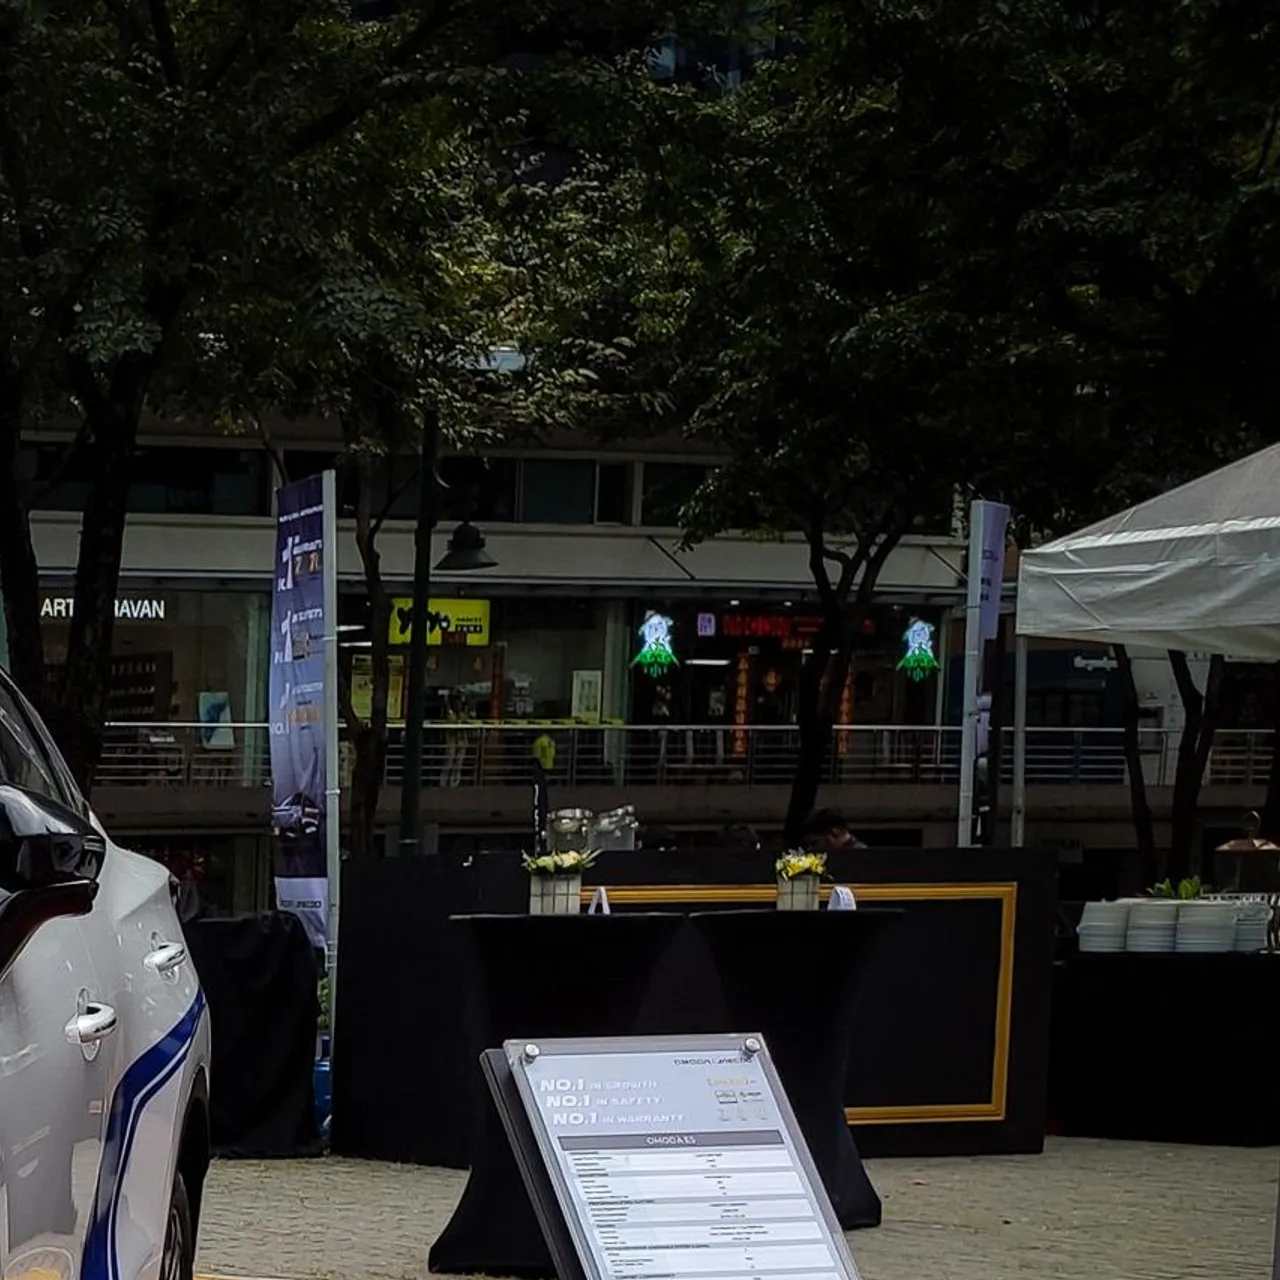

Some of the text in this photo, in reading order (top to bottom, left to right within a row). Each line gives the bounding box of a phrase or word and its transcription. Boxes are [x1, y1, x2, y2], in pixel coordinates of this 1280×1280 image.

[40, 598, 74, 617] ART
[540, 1078, 585, 1092] NO.1
[546, 1094, 591, 1107] NO.1
[610, 1096, 662, 1106] SAFETY
[553, 1111, 599, 1125] NO.1
[616, 1113, 685, 1124] WARRANTY
